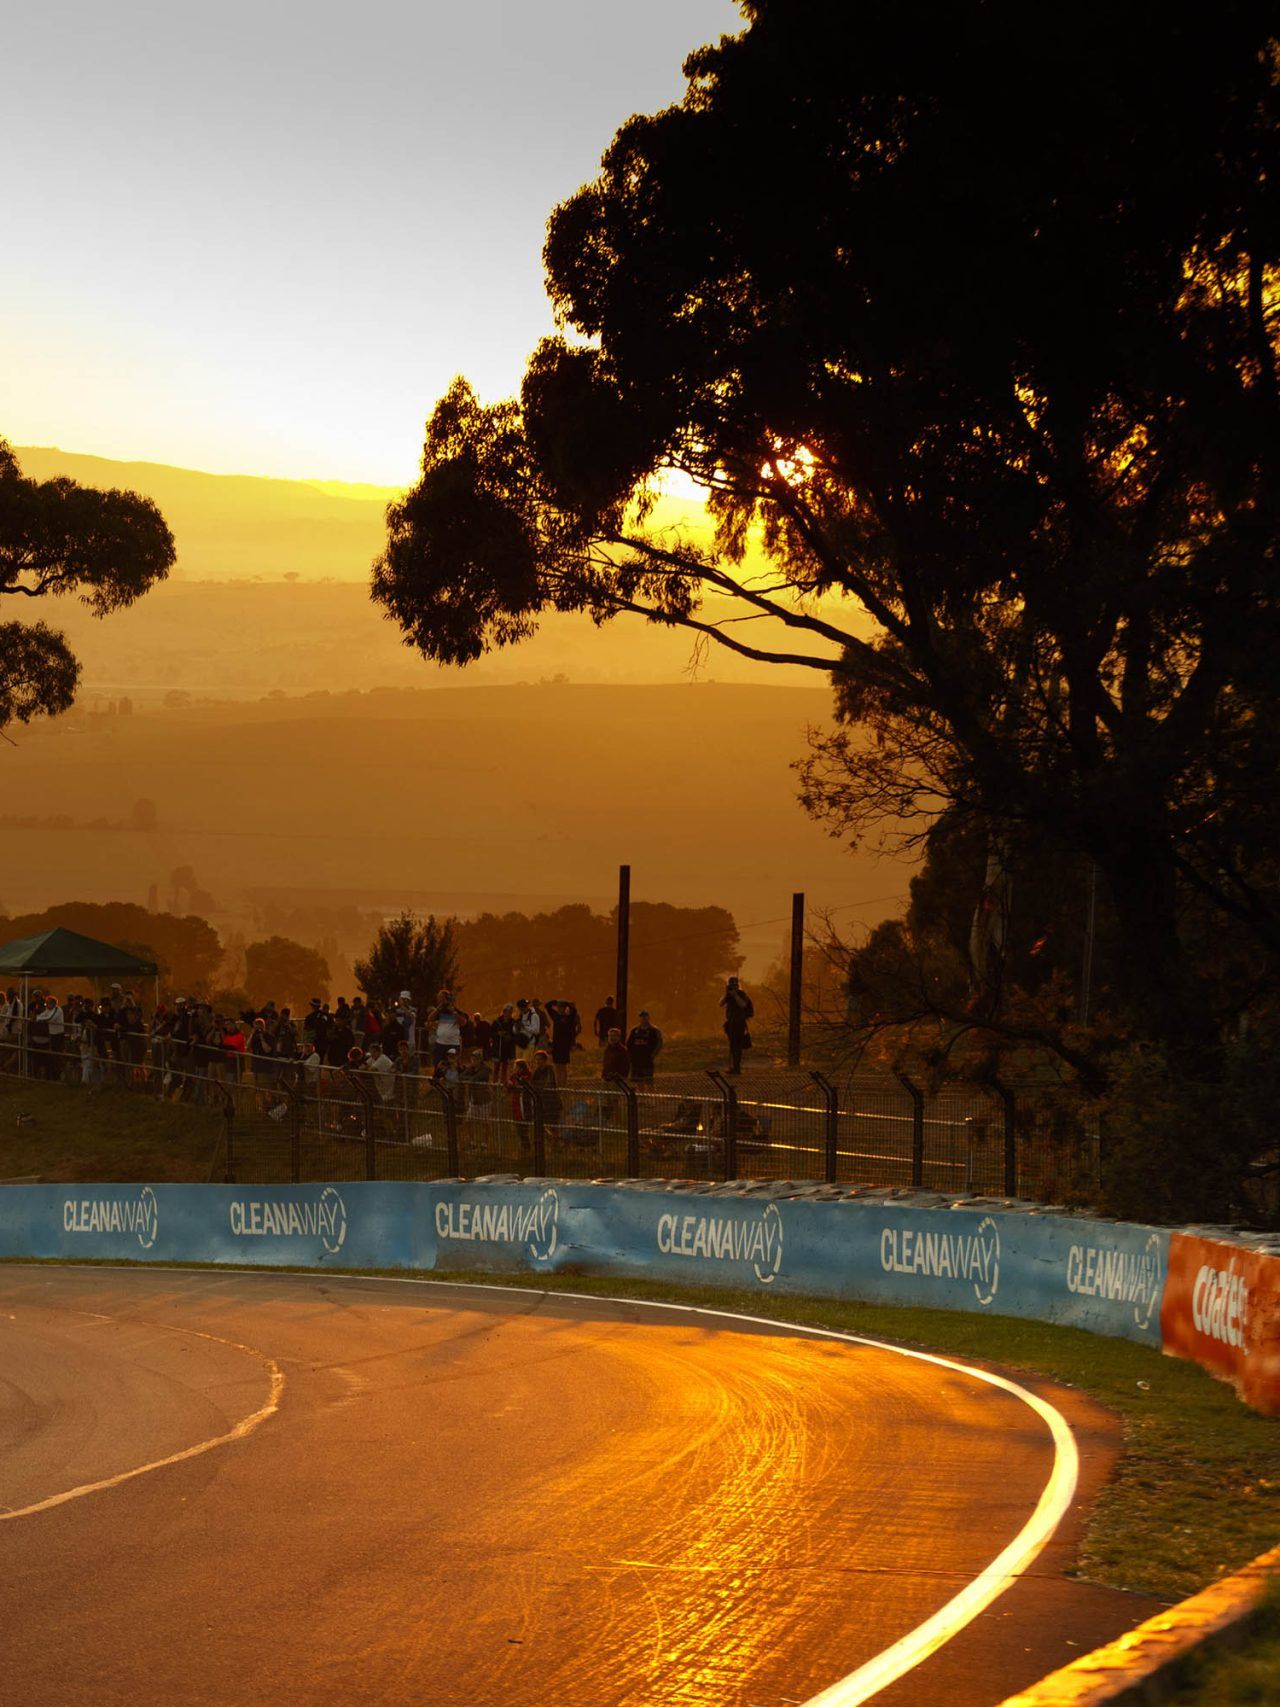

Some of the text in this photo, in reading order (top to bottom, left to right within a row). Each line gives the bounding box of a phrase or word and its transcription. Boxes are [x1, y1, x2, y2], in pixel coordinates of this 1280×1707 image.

[63, 1201, 152, 1233] CLEANAWAY
[229, 1202, 340, 1237] CLEANAWAY
[436, 1202, 553, 1242] CLEANAWAY
[657, 1213, 777, 1261] CLEANAWAY
[880, 1227, 995, 1282] CLEANAWAY
[1067, 1244, 1156, 1304] CLEANAWAY
